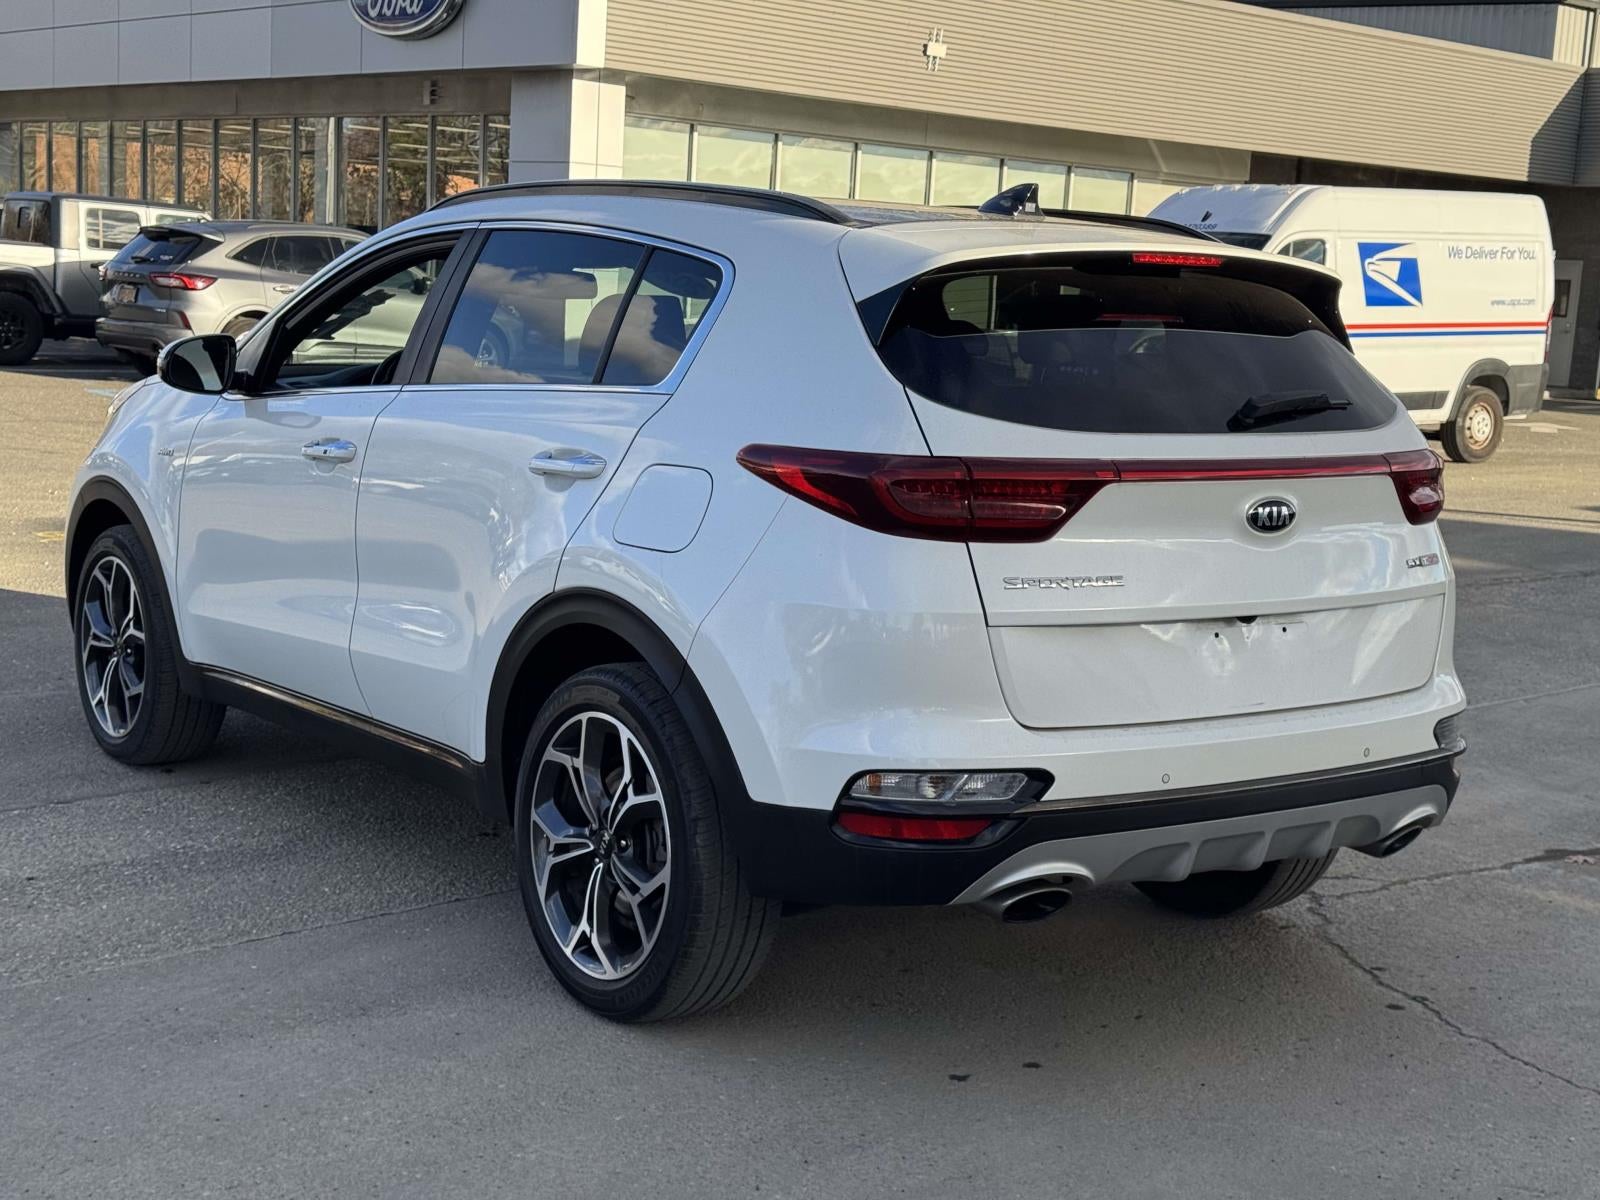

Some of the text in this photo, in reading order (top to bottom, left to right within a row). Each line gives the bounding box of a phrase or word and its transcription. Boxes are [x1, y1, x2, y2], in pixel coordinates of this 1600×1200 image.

[1447, 246, 1463, 259] We
[1465, 246, 1499, 259] Deliver
[1500, 246, 1516, 260] For
[1257, 506, 1290, 526] KIA
[1003, 575, 1125, 590] SPORTAGE
